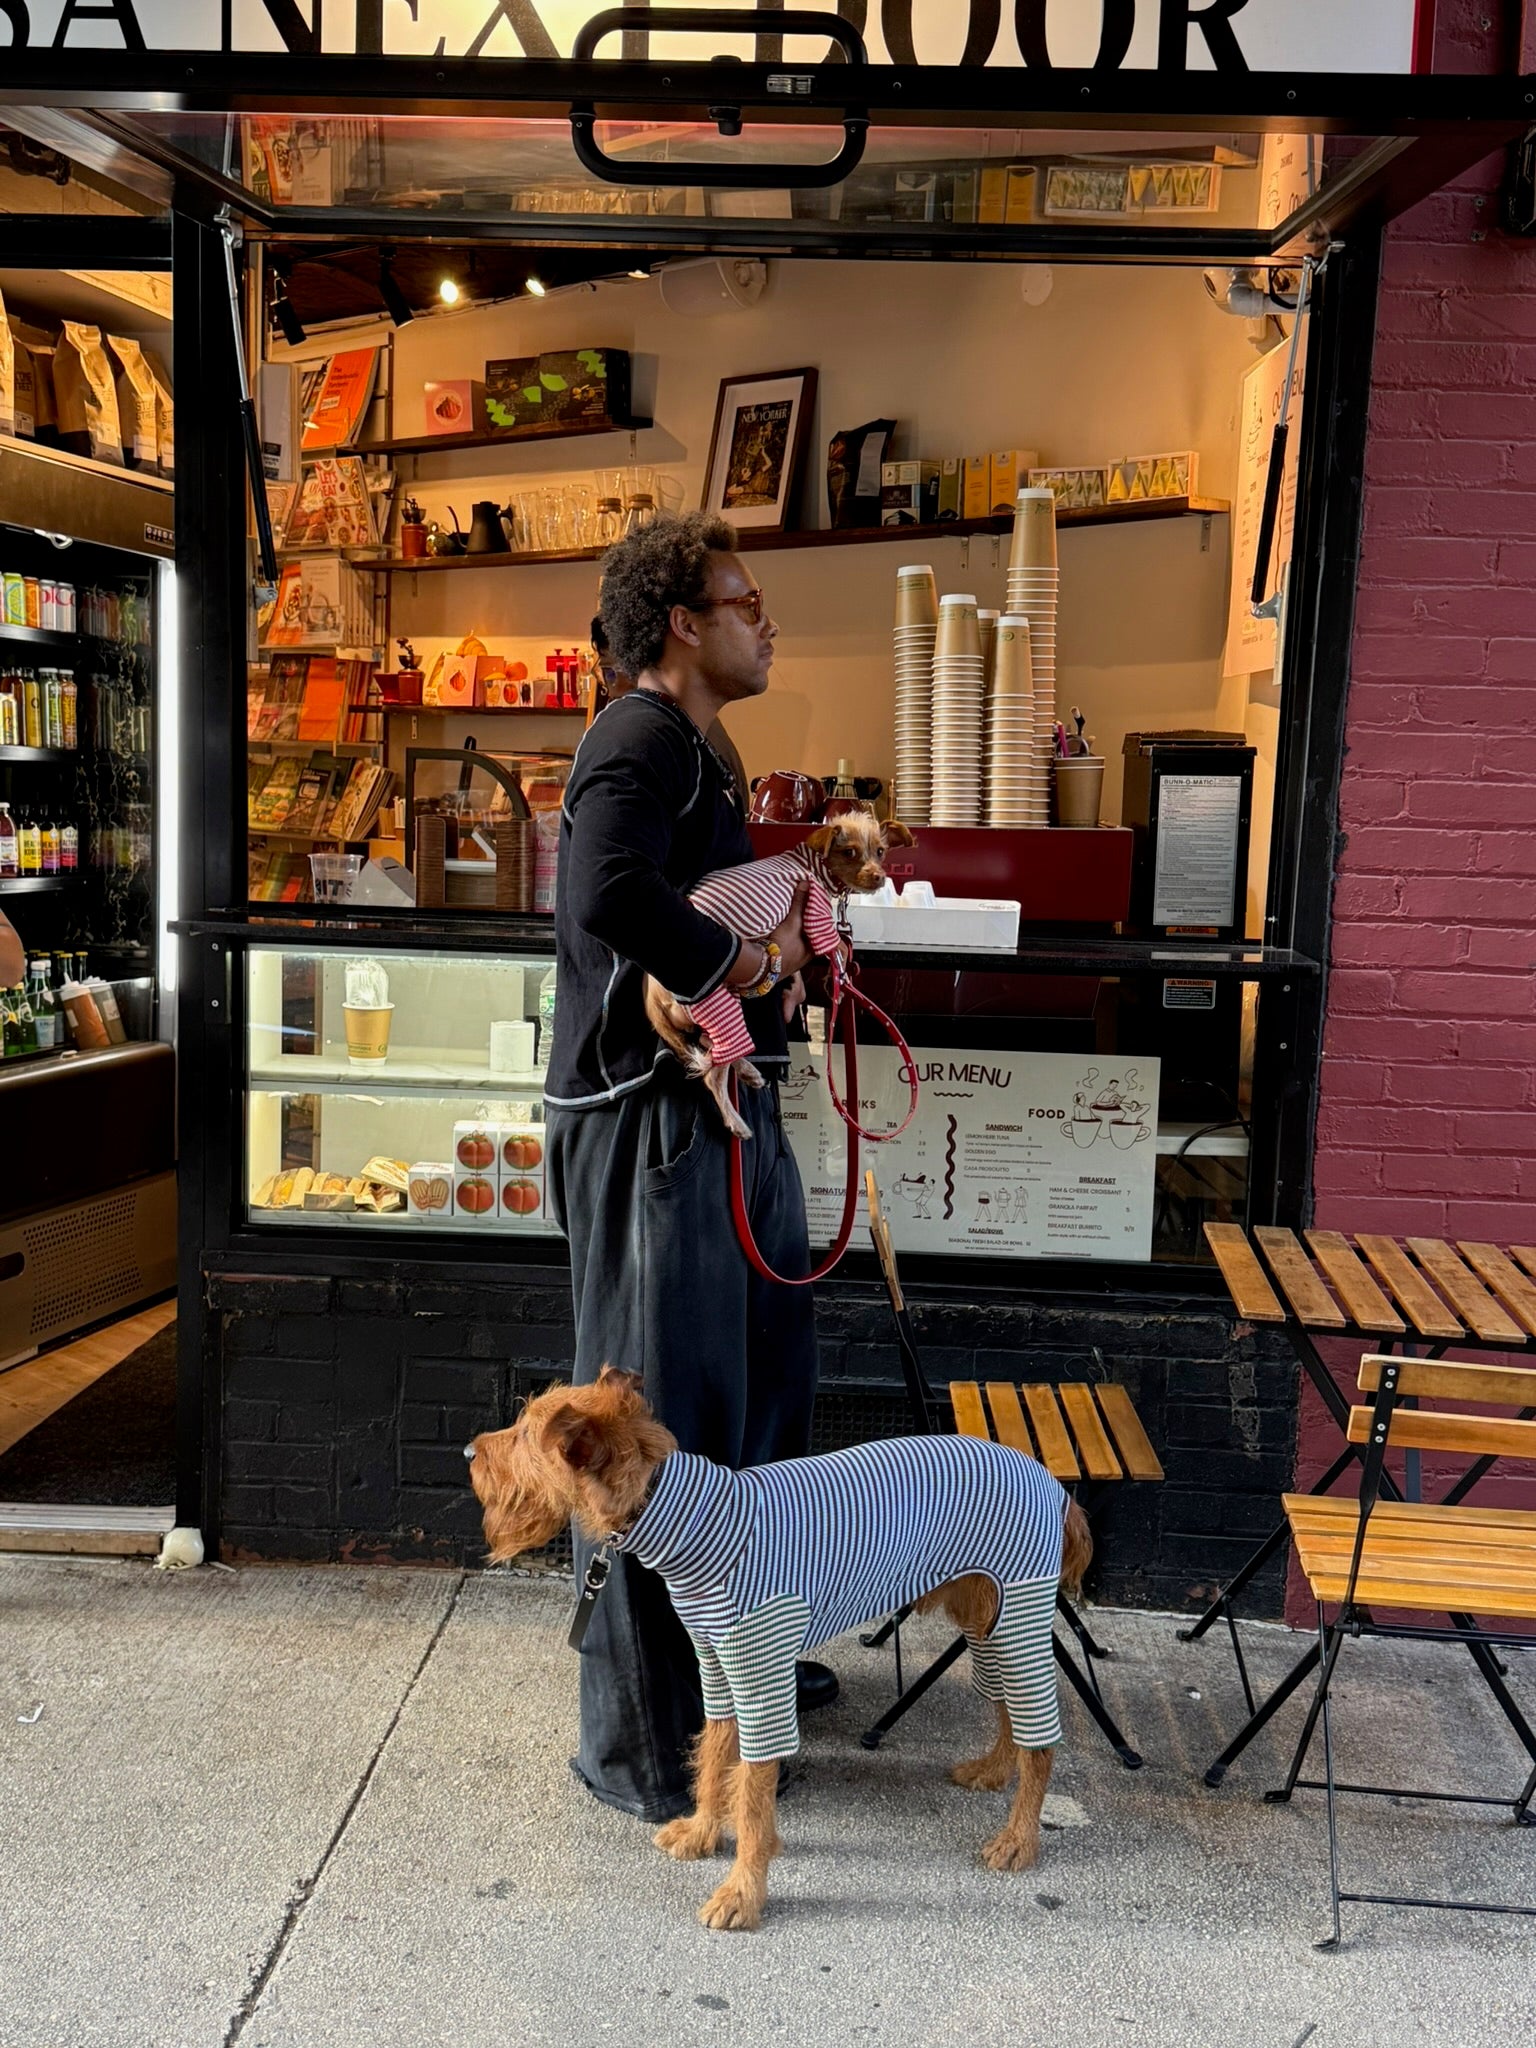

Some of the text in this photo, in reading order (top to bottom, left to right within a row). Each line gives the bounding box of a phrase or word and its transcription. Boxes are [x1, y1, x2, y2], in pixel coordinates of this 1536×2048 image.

[322, 485, 336, 497] EAT
[1177, 979, 1211, 987] WARNING
[898, 1063, 1012, 1088] OUR MENU
[783, 1111, 808, 1119] COFFEE
[1028, 1108, 1065, 1119] FOOD
[985, 1124, 1023, 1133] SANDWICH
[1079, 1176, 1116, 1185] BREAKFAST
[1090, 1188, 1122, 1196] CROISSANT
